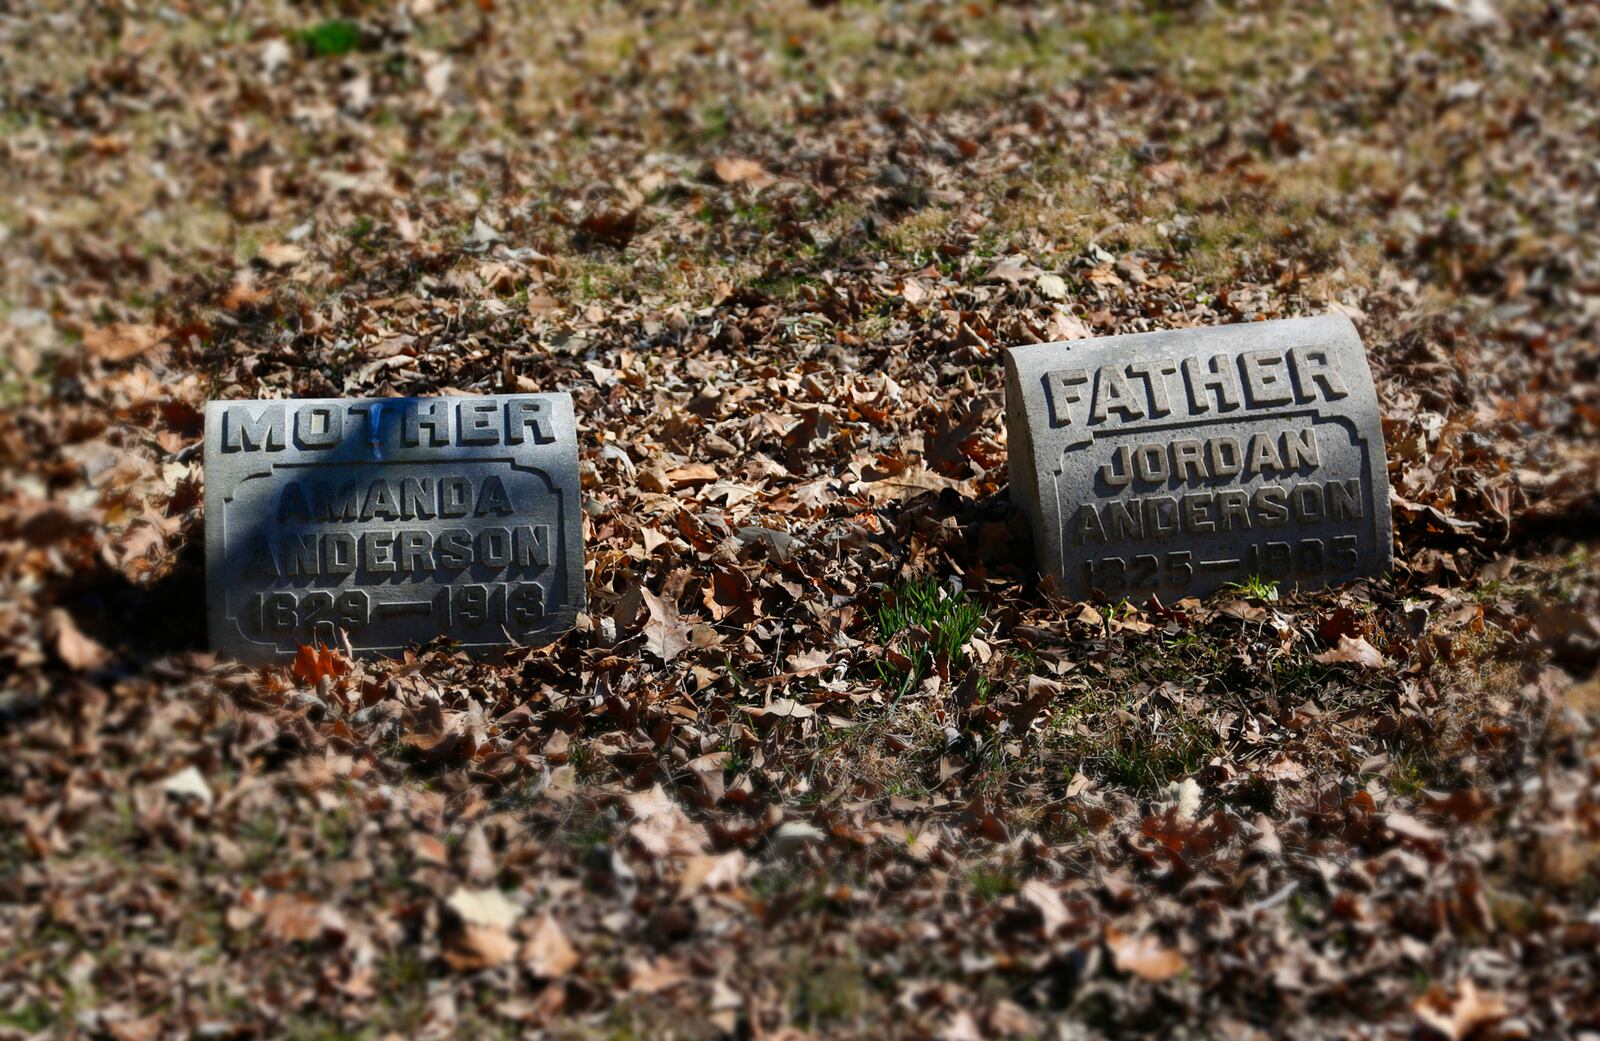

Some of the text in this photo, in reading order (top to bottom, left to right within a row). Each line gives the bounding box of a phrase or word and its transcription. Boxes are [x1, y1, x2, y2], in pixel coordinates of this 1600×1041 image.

[1041, 345, 1349, 428] FATHER
[222, 398, 556, 452] MOTHER
[1099, 427, 1320, 489] JORDAN
[279, 475, 514, 521] AMANDA
[1077, 478, 1364, 543] ANDERSON
[248, 525, 551, 577] ANDERSON
